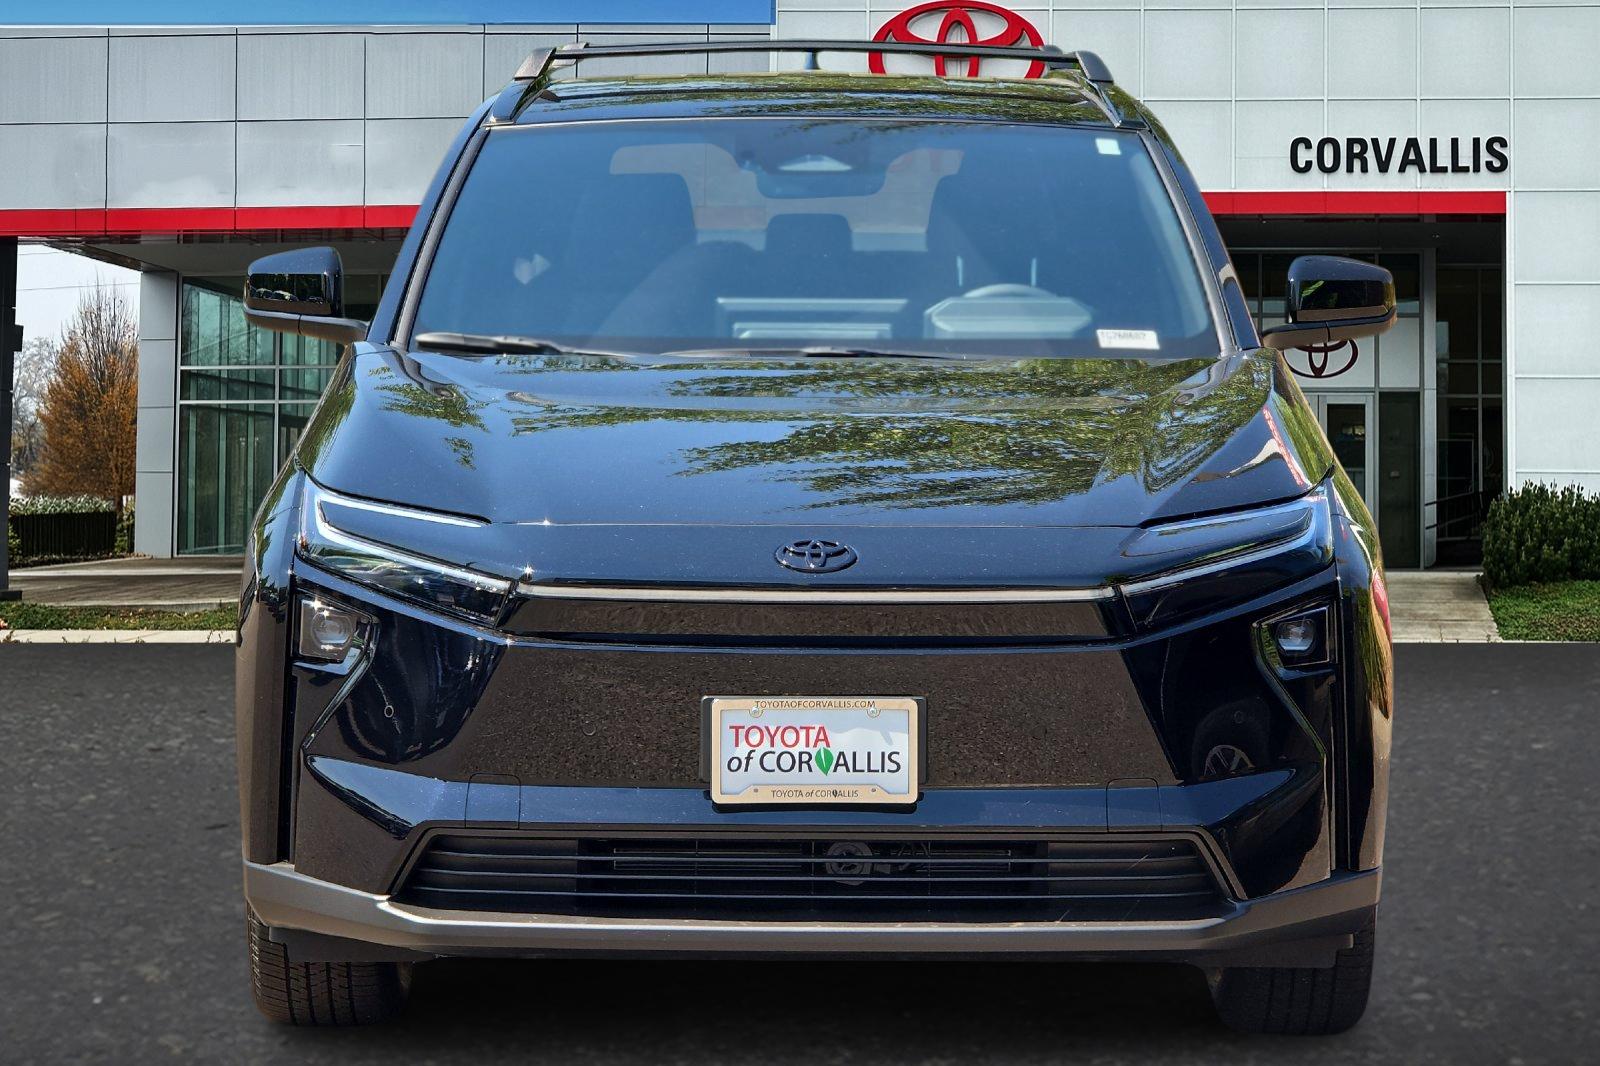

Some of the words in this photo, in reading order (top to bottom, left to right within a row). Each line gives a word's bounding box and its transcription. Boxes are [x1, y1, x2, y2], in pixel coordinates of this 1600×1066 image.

[1290, 137, 1509, 173] CORVALLIS
[755, 700, 876, 709] TOYOTAOFCORVALLIS.COM
[729, 725, 831, 748] TOYOTA
[727, 750, 755, 773] of
[771, 790, 804, 798] TOYOTA
[805, 789, 814, 798] of
